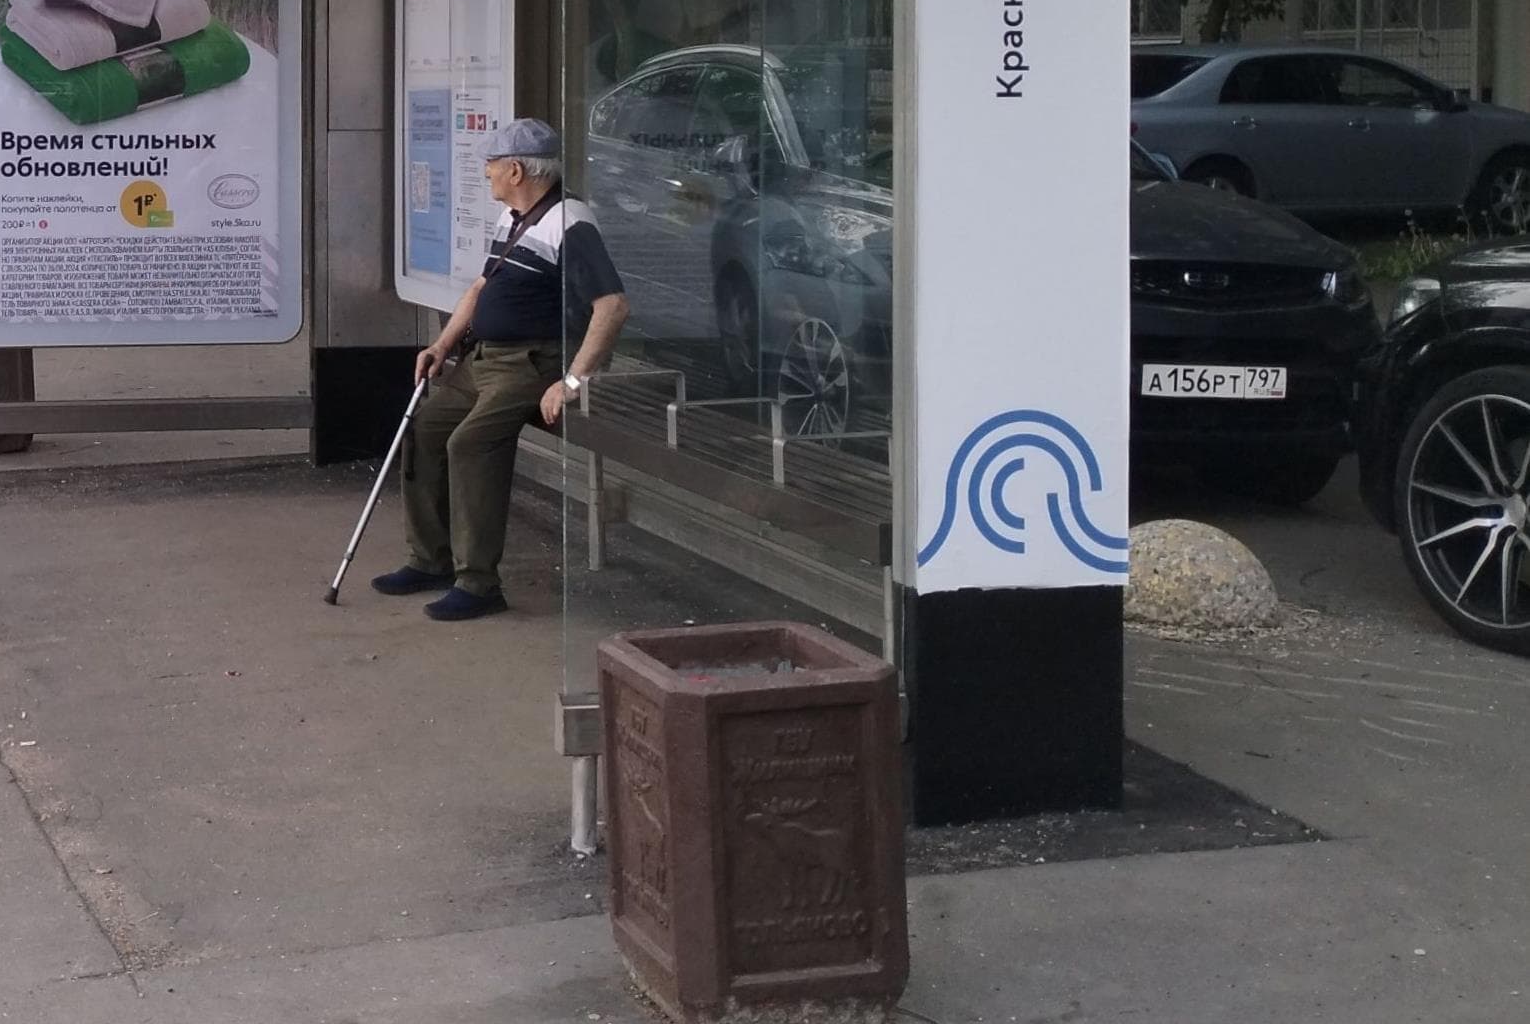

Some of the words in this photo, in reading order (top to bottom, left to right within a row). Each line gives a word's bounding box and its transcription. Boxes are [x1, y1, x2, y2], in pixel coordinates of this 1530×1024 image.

[0, 131, 84, 155] Время
[91, 132, 217, 151] стильных
[0, 155, 169, 177] обновлений!
[1, 194, 35, 204] Копите
[37, 193, 84, 205] наклейки,
[1, 203, 52, 214] покупайте
[54, 204, 104, 214] полотенца
[106, 204, 117, 213] от
[1149, 367, 1241, 394] А156РТ
[1247, 369, 1281, 388] 797
